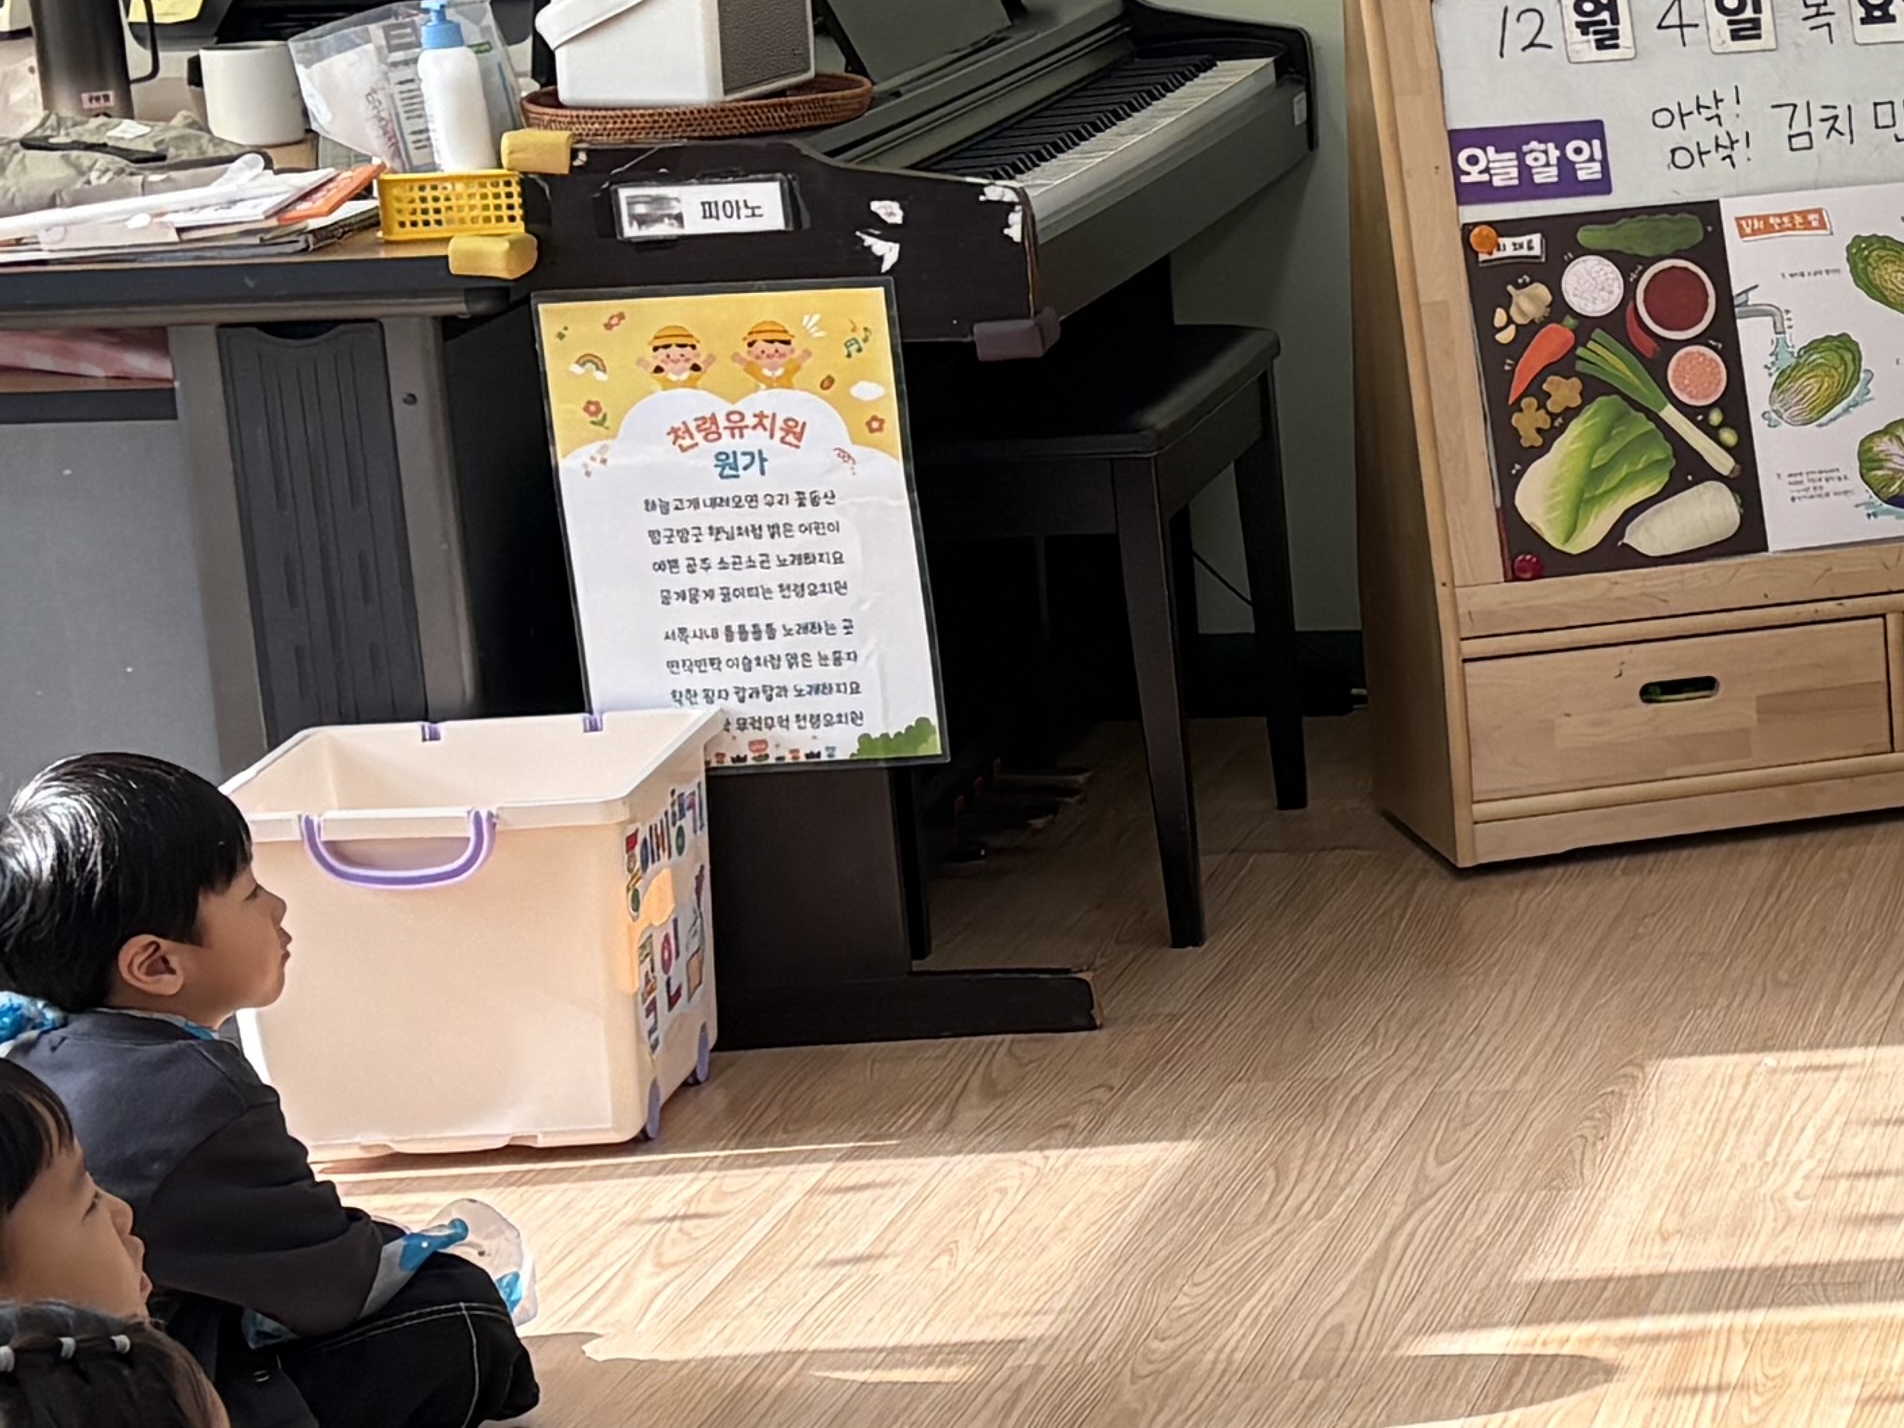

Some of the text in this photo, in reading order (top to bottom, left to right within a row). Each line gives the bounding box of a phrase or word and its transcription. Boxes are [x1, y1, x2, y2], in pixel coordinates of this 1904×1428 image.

[1770, 99, 1856, 154] 김치
[699, 199, 765, 221] 피아노
[666, 410, 808, 453] 천령유치원
[713, 448, 769, 480] 원가
